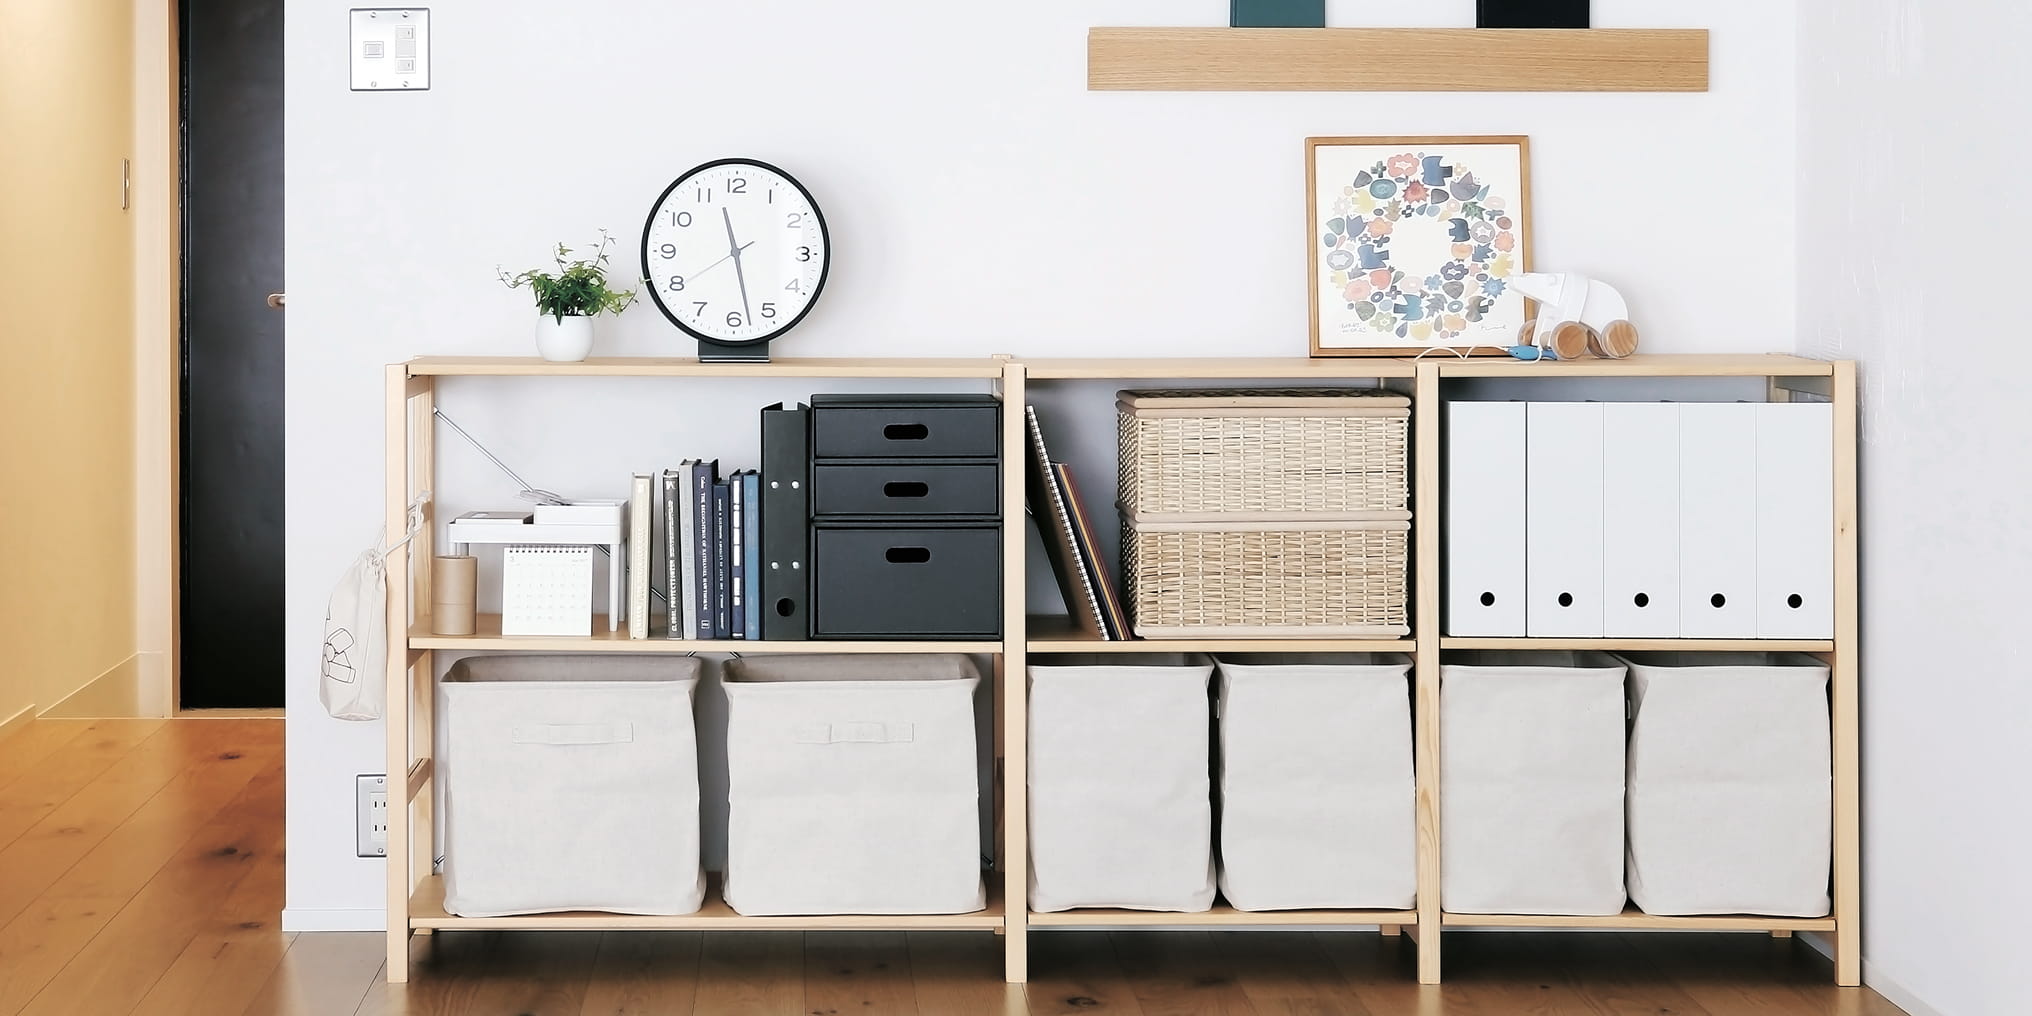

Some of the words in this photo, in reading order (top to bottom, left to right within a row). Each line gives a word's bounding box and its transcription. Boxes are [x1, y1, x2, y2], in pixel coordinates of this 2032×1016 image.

[727, 178, 746, 193] 12
[698, 188, 711, 203] 11
[768, 188, 773, 204] 1
[672, 212, 692, 227] 10
[787, 213, 801, 228] 2
[661, 244, 676, 259] 9
[796, 246, 810, 262] 3
[669, 275, 684, 291] 8
[785, 279, 800, 293] 4
[692, 302, 708, 317] 7
[761, 303, 776, 318] 5
[726, 312, 742, 327] 6
